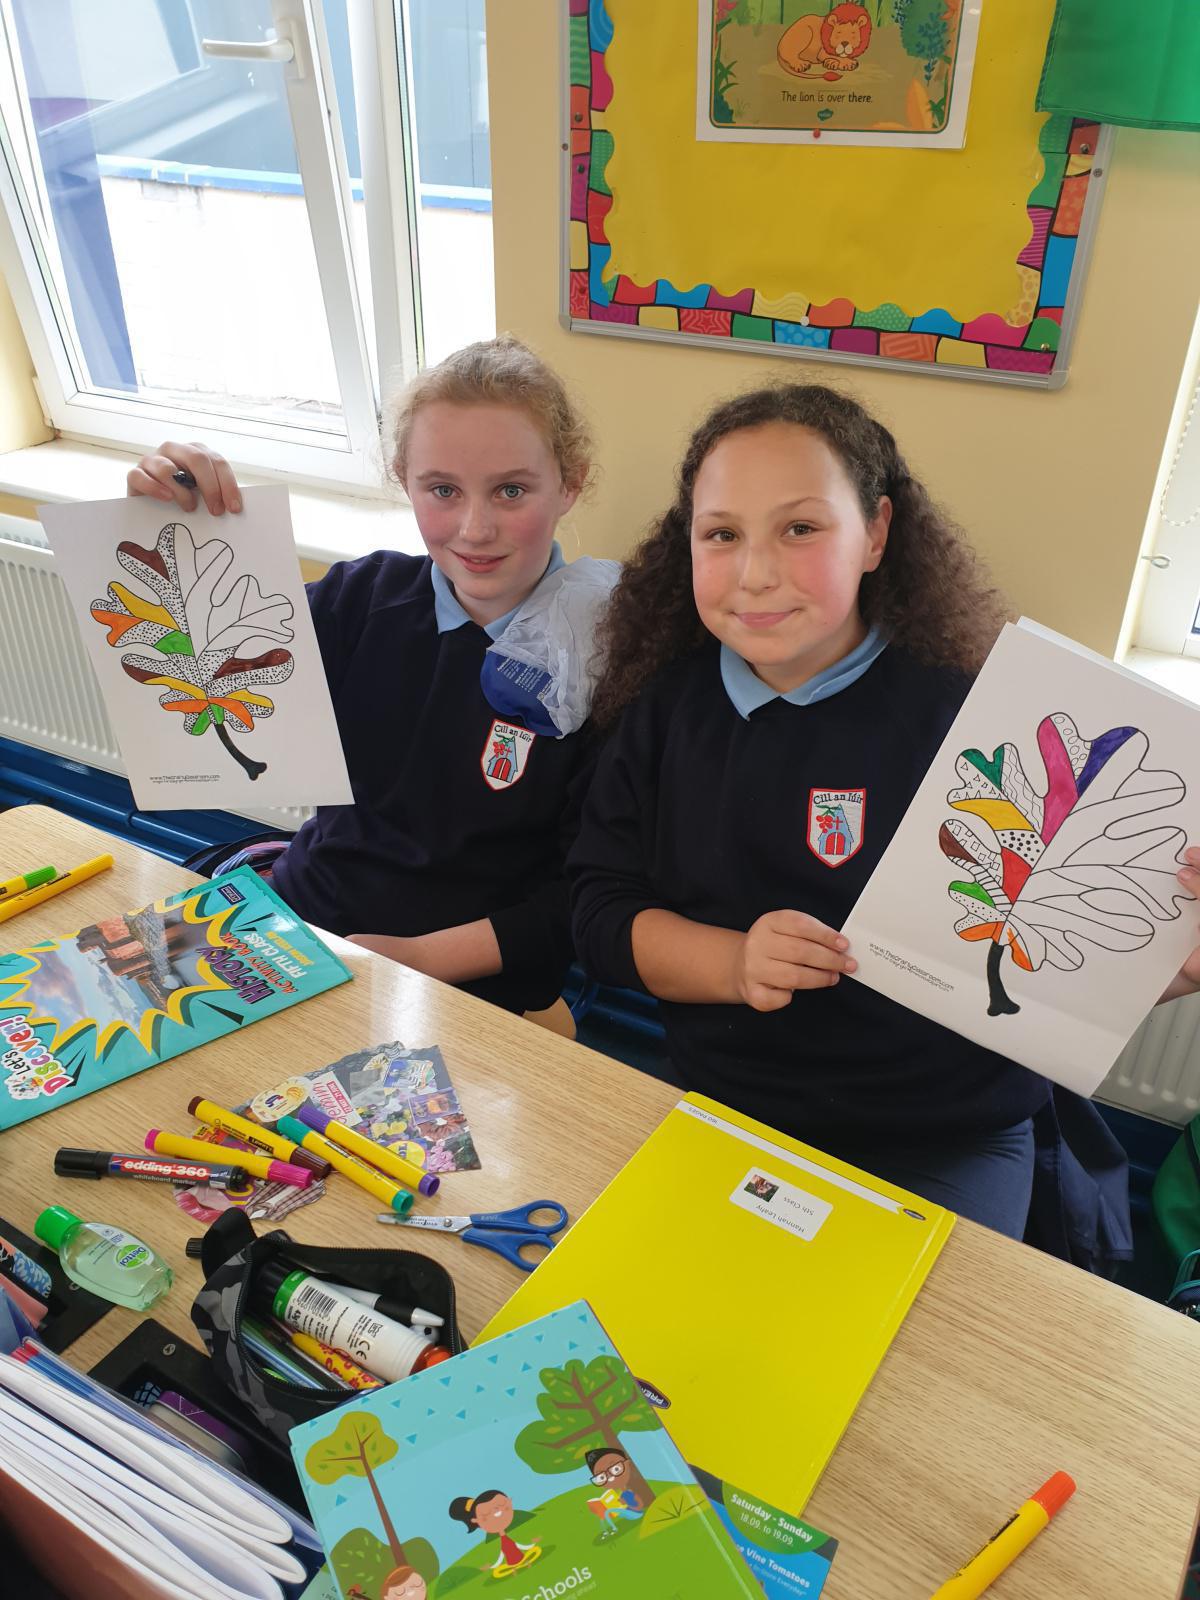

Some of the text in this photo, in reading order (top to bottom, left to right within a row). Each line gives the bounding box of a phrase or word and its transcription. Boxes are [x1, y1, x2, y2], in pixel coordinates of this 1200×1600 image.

[781, 90, 873, 103] The lion is over there.
[509, 728, 519, 736] an
[813, 793, 832, 805] Cill
[220, 931, 254, 956] BOOK
[243, 932, 279, 956] CLASS
[246, 956, 299, 994] ACTIVITY
[272, 954, 307, 978] FIFTH
[5, 1051, 31, 1075] Let's
[124, 1160, 171, 1174] edding
[175, 1165, 207, 1177] 360
[133, 1174, 171, 1182] whiteboard
[783, 1196, 815, 1216] 5th Class
[756, 1205, 805, 1233] Hannah Leahy
[119, 1246, 147, 1268] Dettol
[730, 1493, 772, 1522] Saturday
[777, 1517, 813, 1543] Sunday
[740, 1512, 761, 1530] 18.09.
[763, 1525, 772, 1535] to
[746, 1547, 767, 1564] Vine
[768, 1559, 811, 1588] Tomatoes
